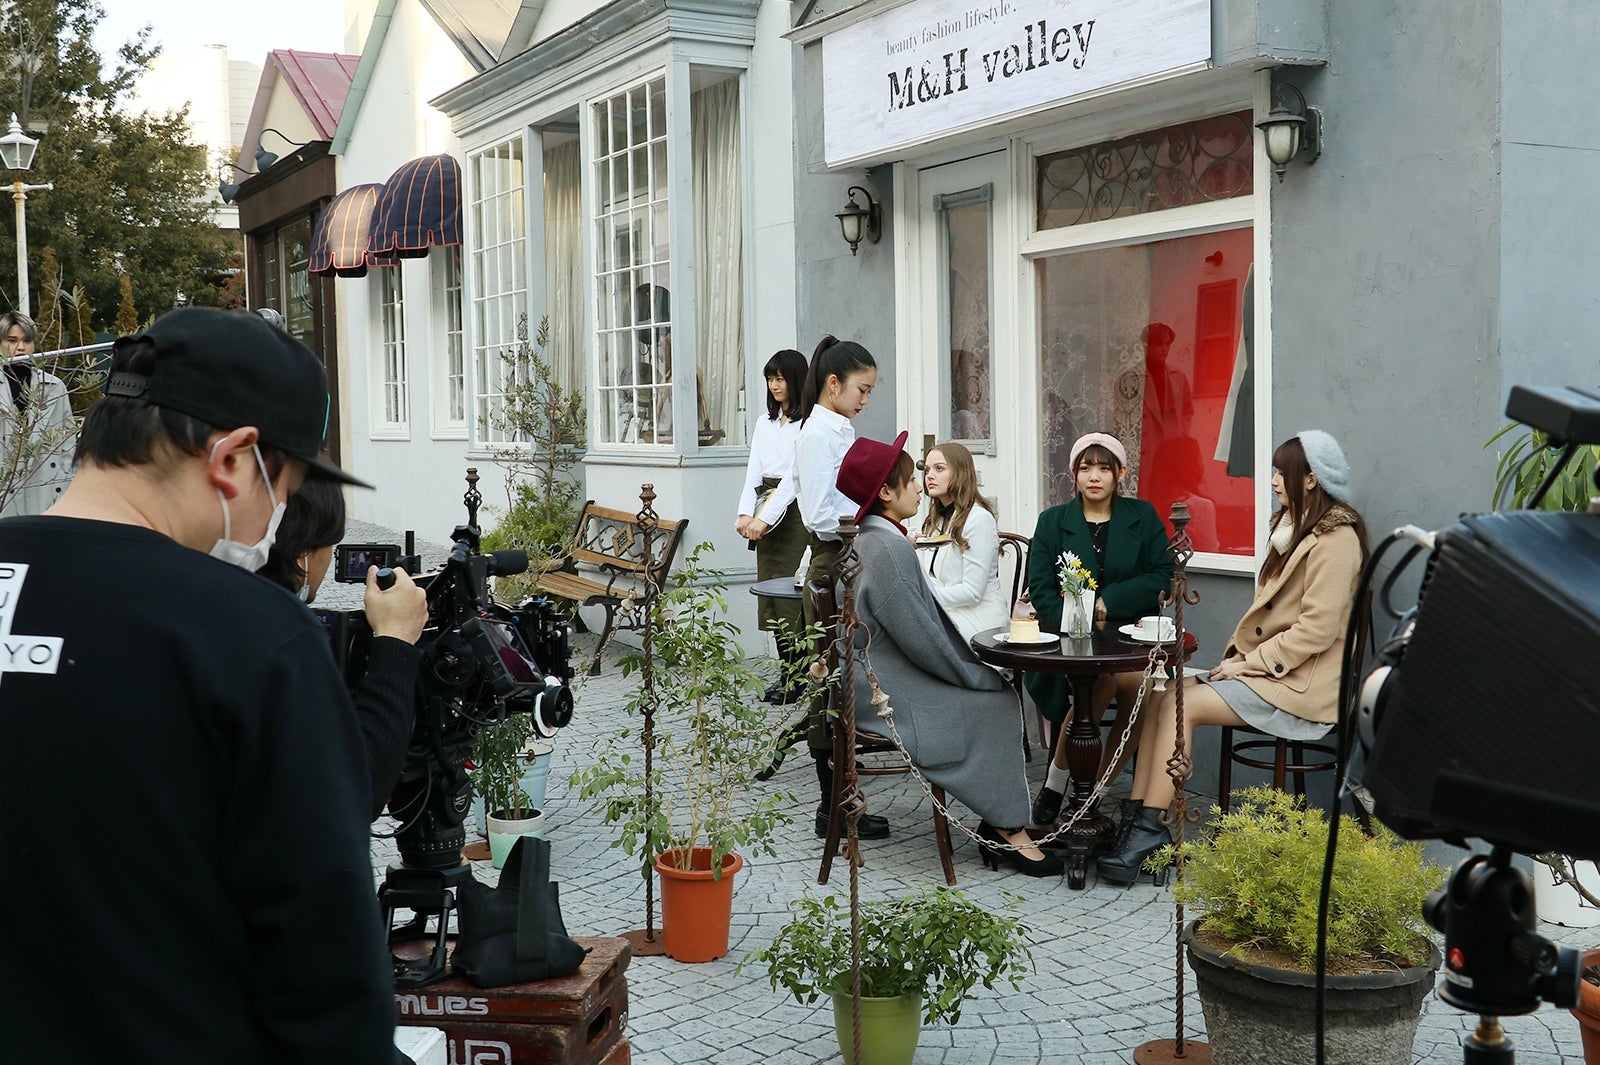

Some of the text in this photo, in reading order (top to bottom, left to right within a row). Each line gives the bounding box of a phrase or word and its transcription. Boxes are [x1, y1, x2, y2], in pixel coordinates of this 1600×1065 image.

[886, 34, 919, 56] beauty
[921, 20, 961, 45] fashion
[887, 19, 1096, 113] M&H valley
